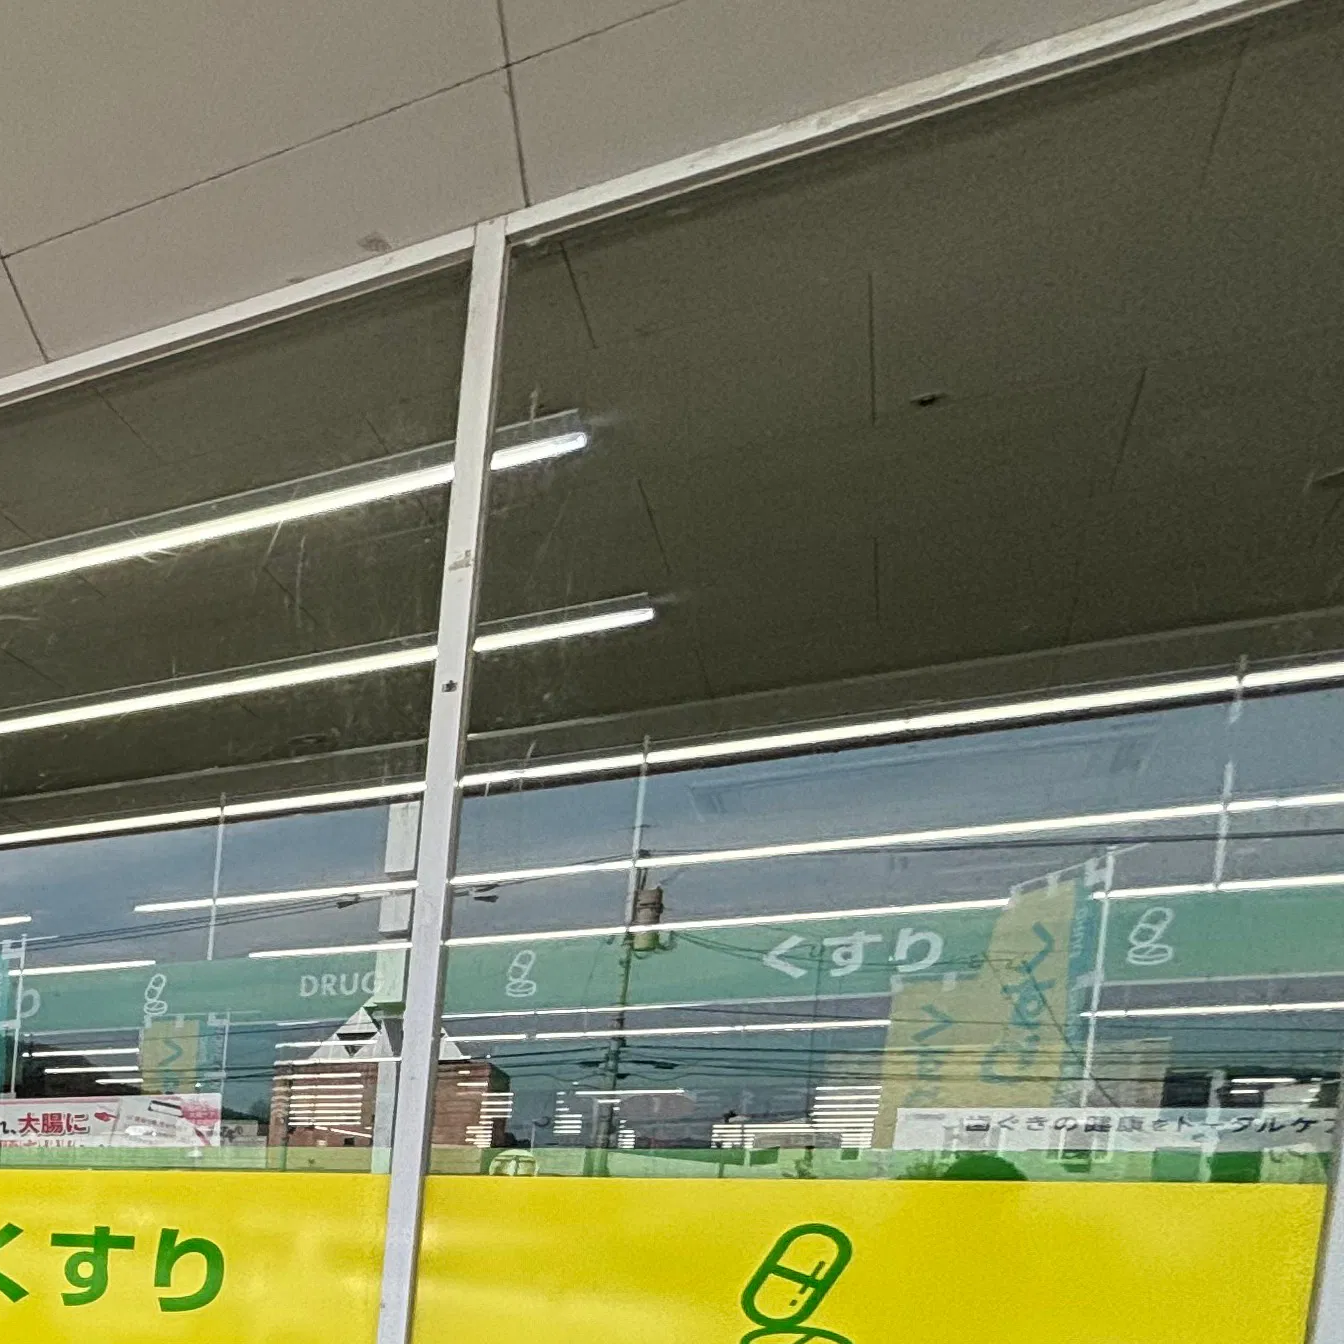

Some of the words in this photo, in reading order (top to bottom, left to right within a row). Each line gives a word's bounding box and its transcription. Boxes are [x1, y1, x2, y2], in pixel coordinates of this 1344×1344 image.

[761, 926, 944, 979] くすり
[299, 970, 384, 997] DRUG
